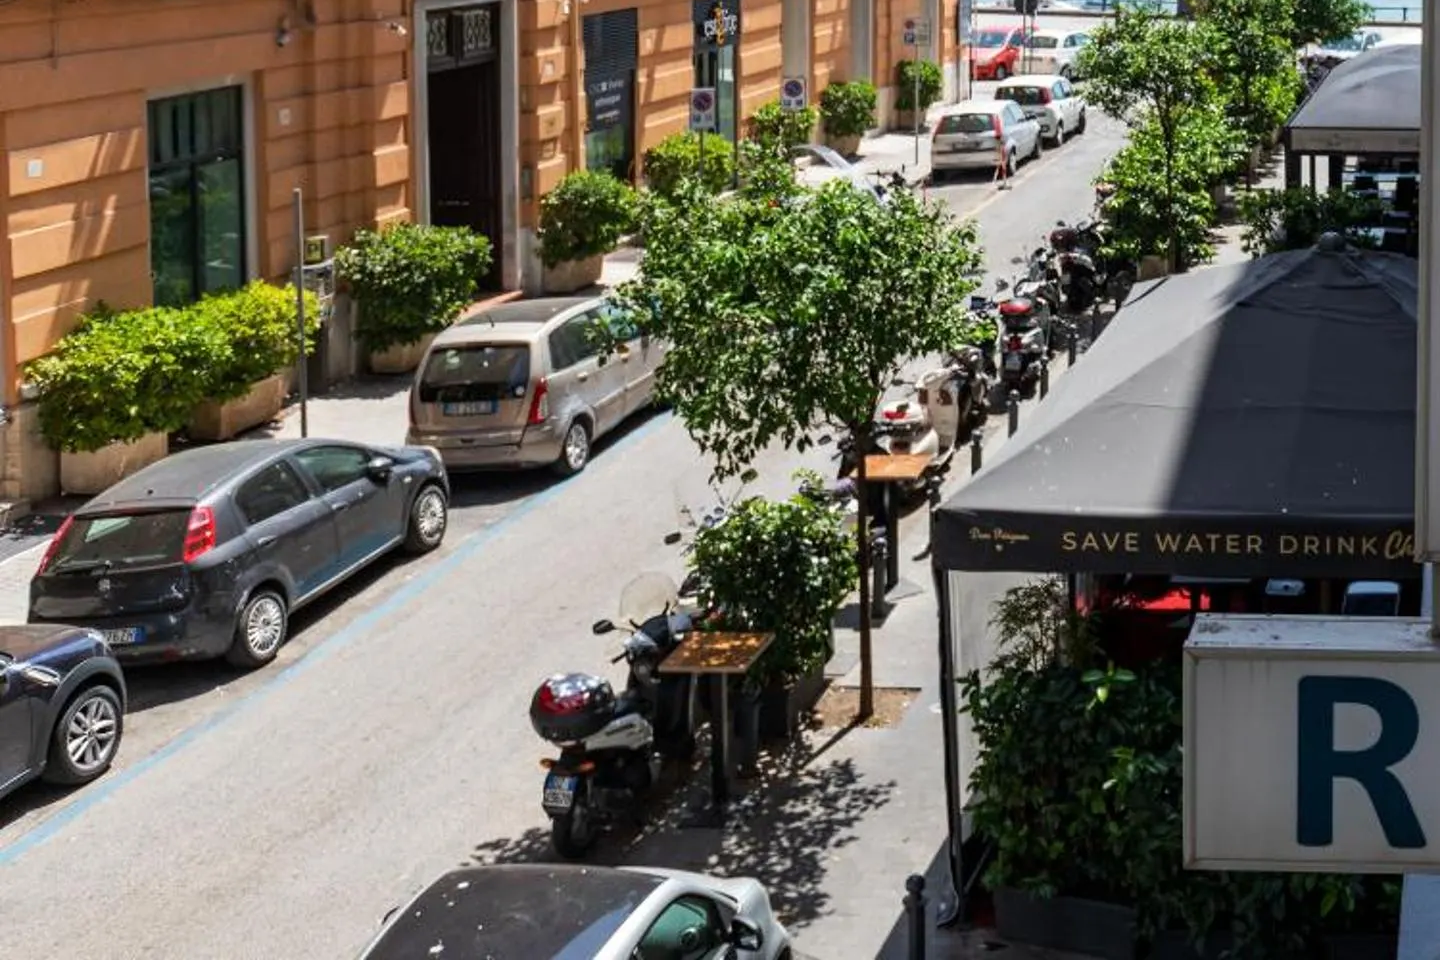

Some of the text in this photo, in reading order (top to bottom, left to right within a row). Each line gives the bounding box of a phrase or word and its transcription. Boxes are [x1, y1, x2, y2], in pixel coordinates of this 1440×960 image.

[1061, 530, 1141, 553] SAVE
[1154, 532, 1263, 554] WATER
[1279, 534, 1379, 556] DRINK
